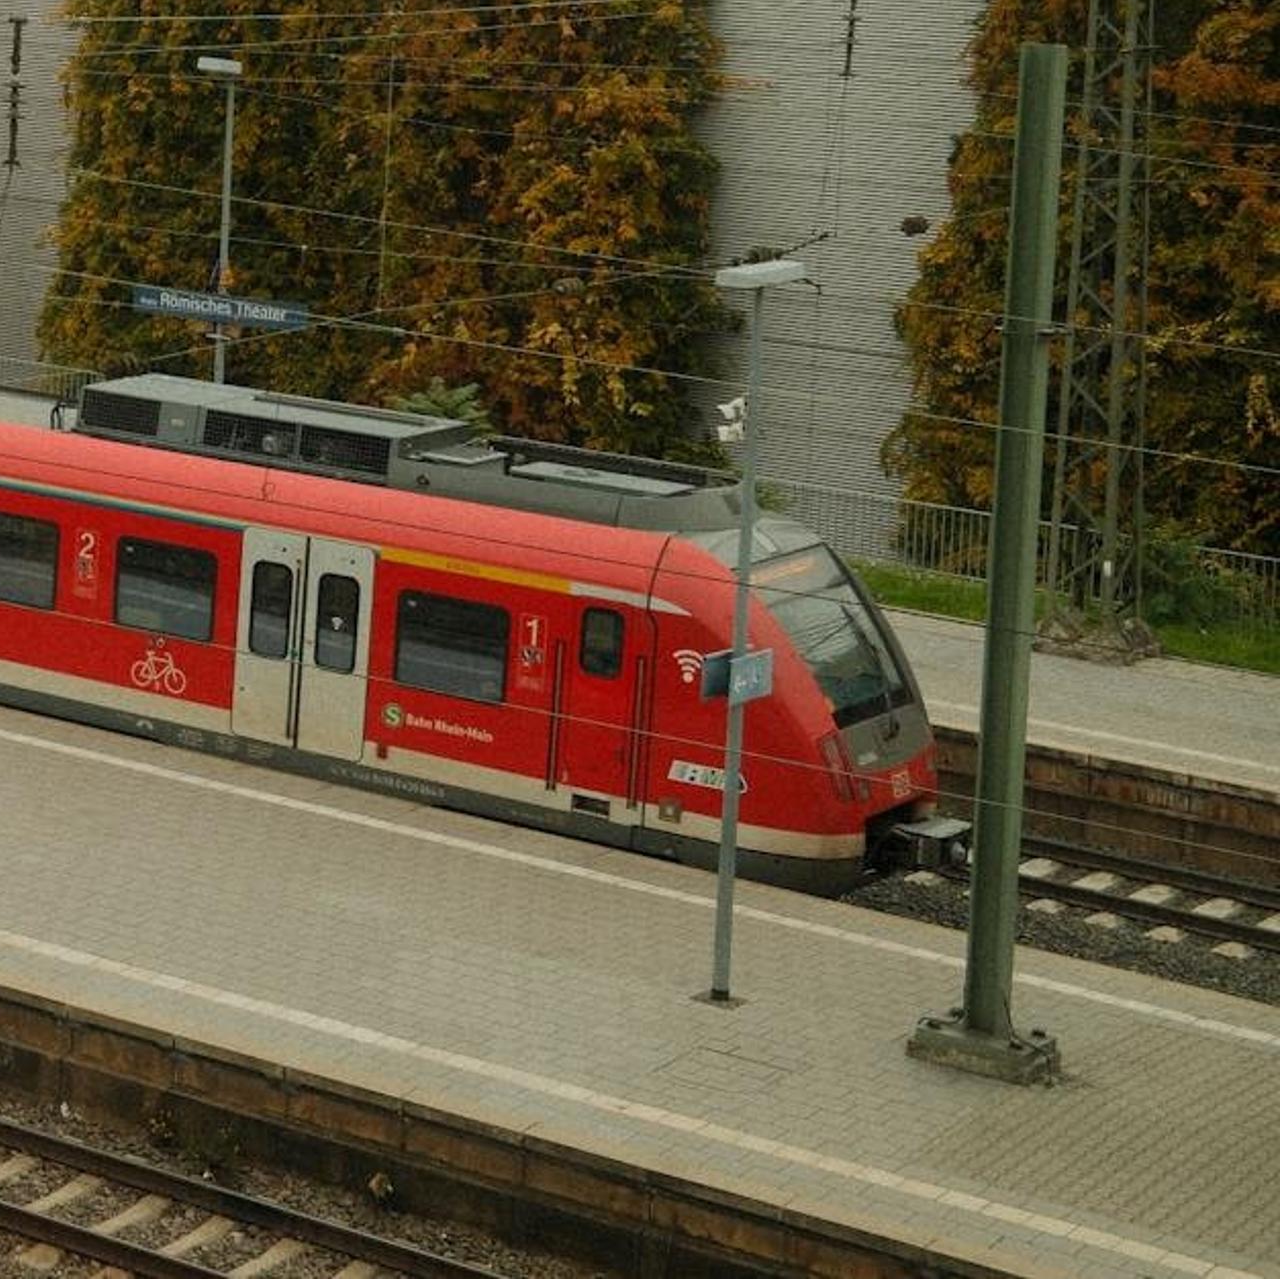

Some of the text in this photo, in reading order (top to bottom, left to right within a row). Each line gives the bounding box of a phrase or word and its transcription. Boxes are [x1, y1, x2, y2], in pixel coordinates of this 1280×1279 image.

[159, 292, 232, 315] Römisches
[233, 300, 287, 322] Theater
[79, 532, 95, 559] 2
[526, 617, 539, 647] 1
[383, 704, 402, 726] S
[405, 712, 433, 730] Bahn
